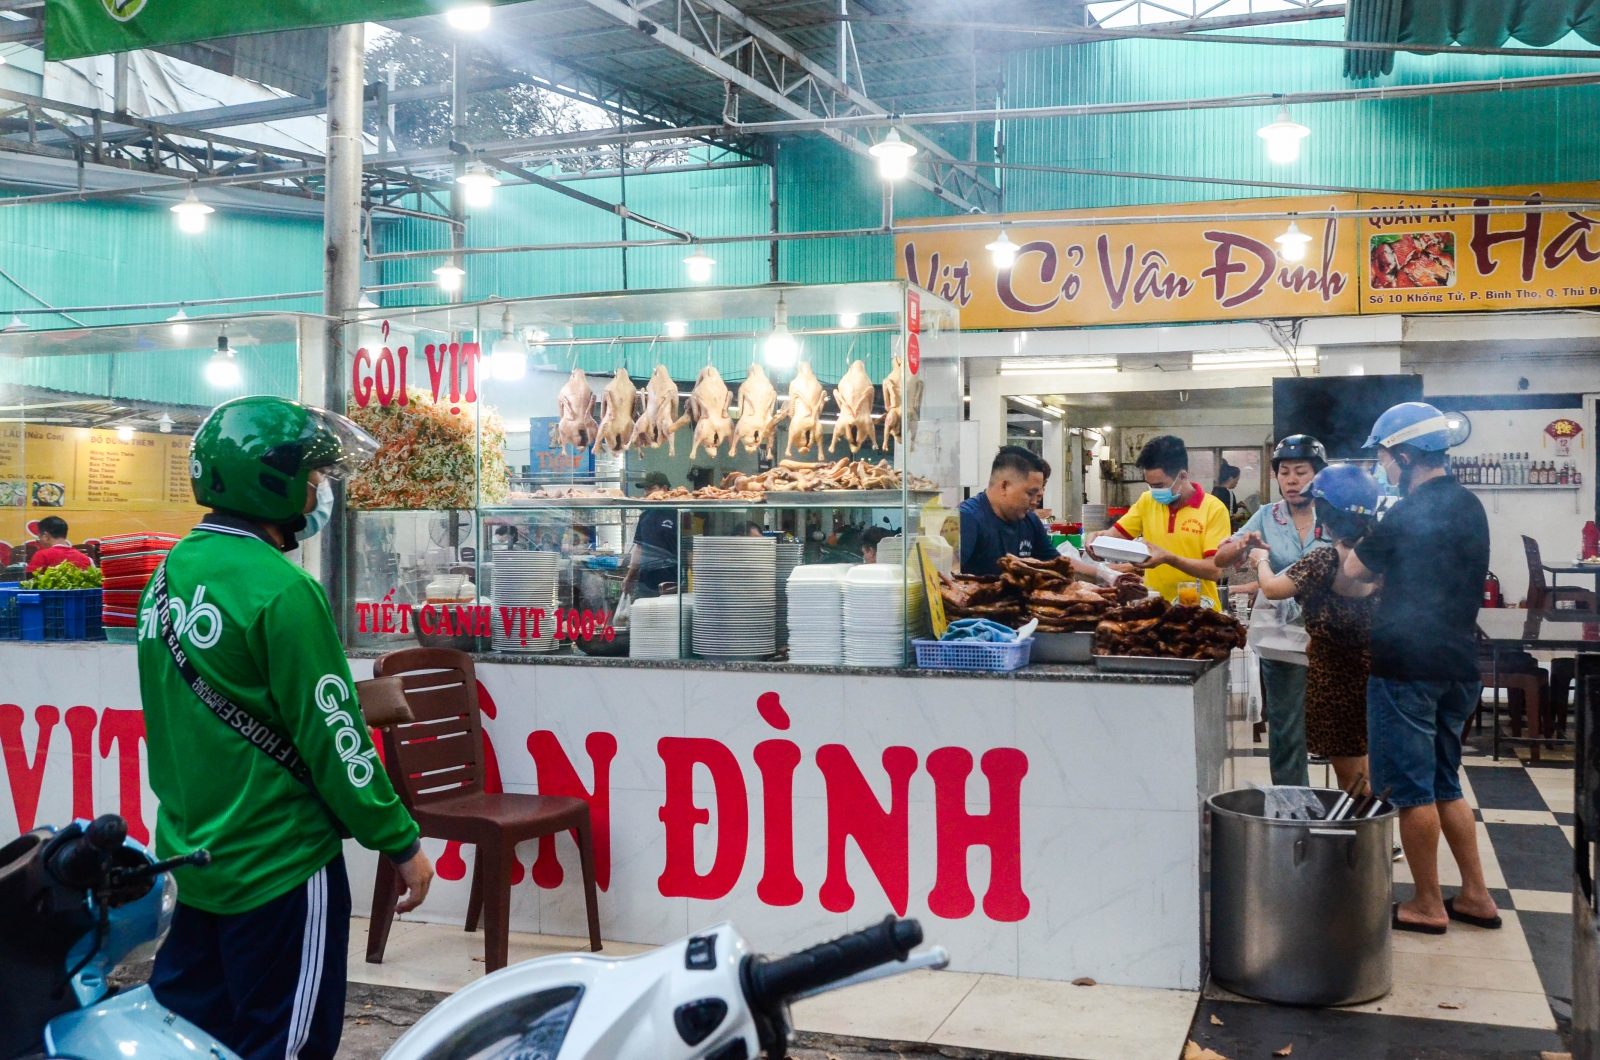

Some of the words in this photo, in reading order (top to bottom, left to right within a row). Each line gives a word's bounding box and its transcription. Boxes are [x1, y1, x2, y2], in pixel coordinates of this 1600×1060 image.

[1368, 199, 1422, 230] QUÁN
[1428, 199, 1456, 223] ĂN
[1098, 233, 1195, 310] Vân
[1388, 294, 1403, 303] 10
[1470, 290, 1482, 300] P.
[1485, 290, 1512, 300] Bình
[1545, 288, 1558, 298] Q.
[1562, 286, 1585, 296] Thủ
[1588, 286, 1600, 295] Đ
[352, 319, 409, 409] GỎI
[423, 341, 481, 416] VỊT
[355, 588, 413, 635] TIẾT
[418, 604, 492, 638] CANH
[499, 606, 546, 647] VỊT
[553, 607, 616, 643] 100%
[191, 682, 222, 713] LIMITED
[195, 676, 228, 707] EDITION
[219, 701, 282, 754] HORSE
[314, 673, 378, 788] Grab
[656, 690, 1031, 923] ĐÌNH
